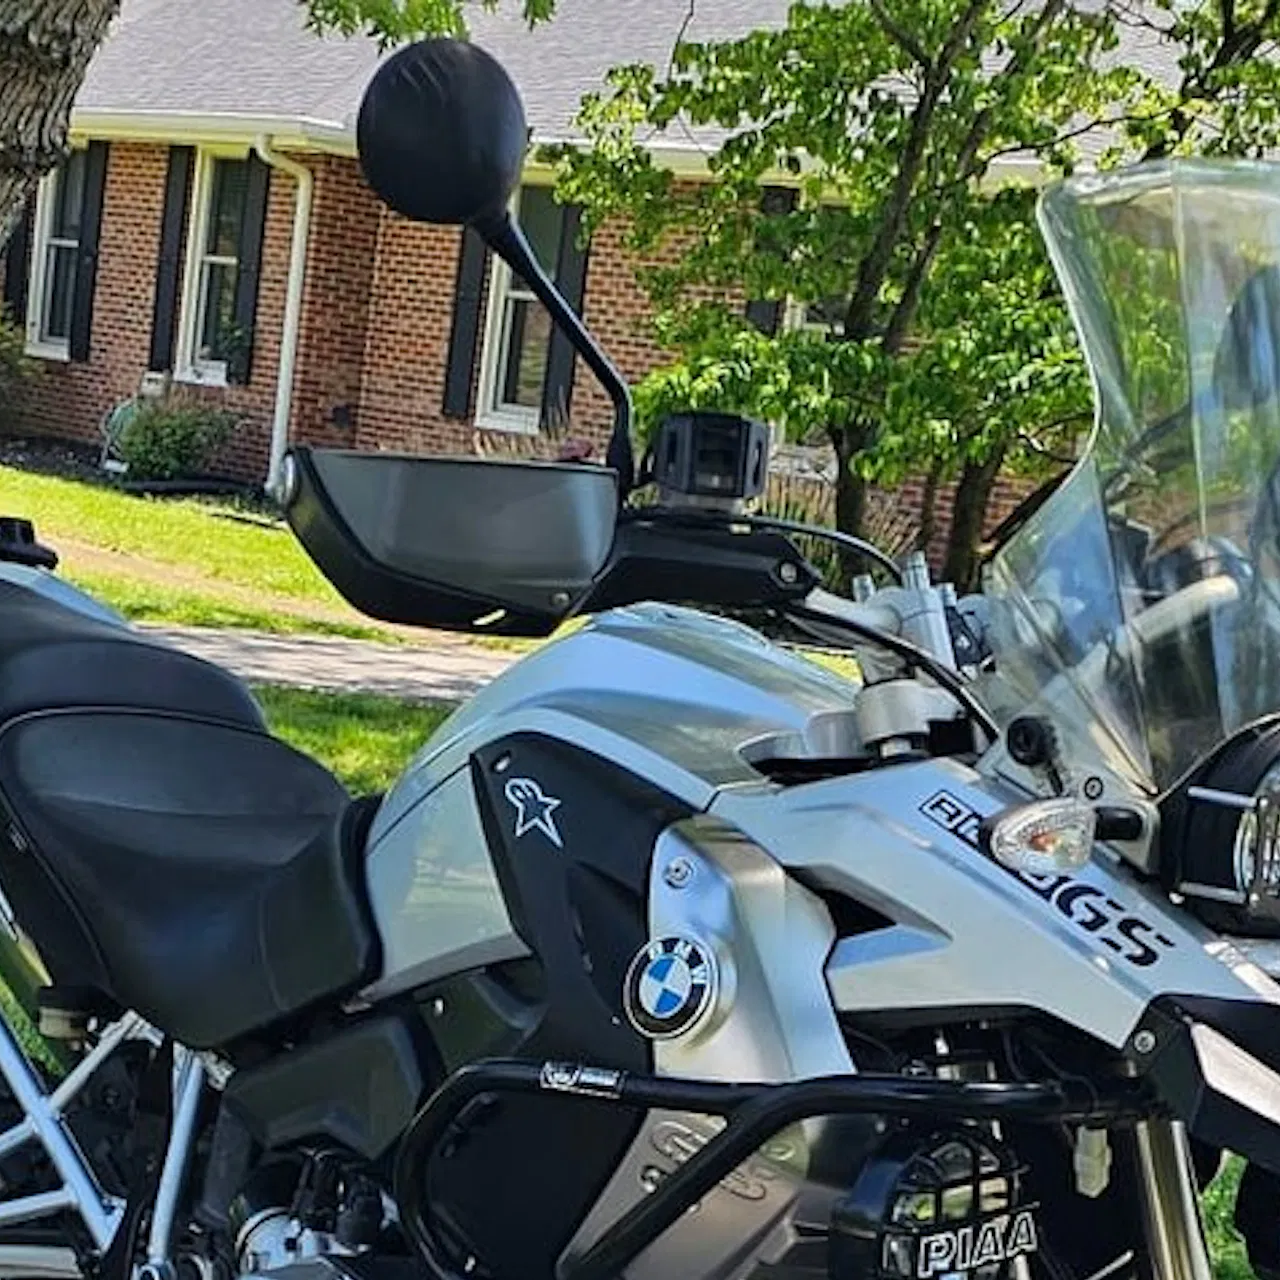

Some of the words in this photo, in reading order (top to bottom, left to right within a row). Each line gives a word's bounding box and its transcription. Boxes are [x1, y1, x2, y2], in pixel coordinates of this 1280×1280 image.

[1053, 884, 1175, 967] GS
[648, 939, 707, 984] BMW
[918, 1211, 1039, 1279] PIAA
